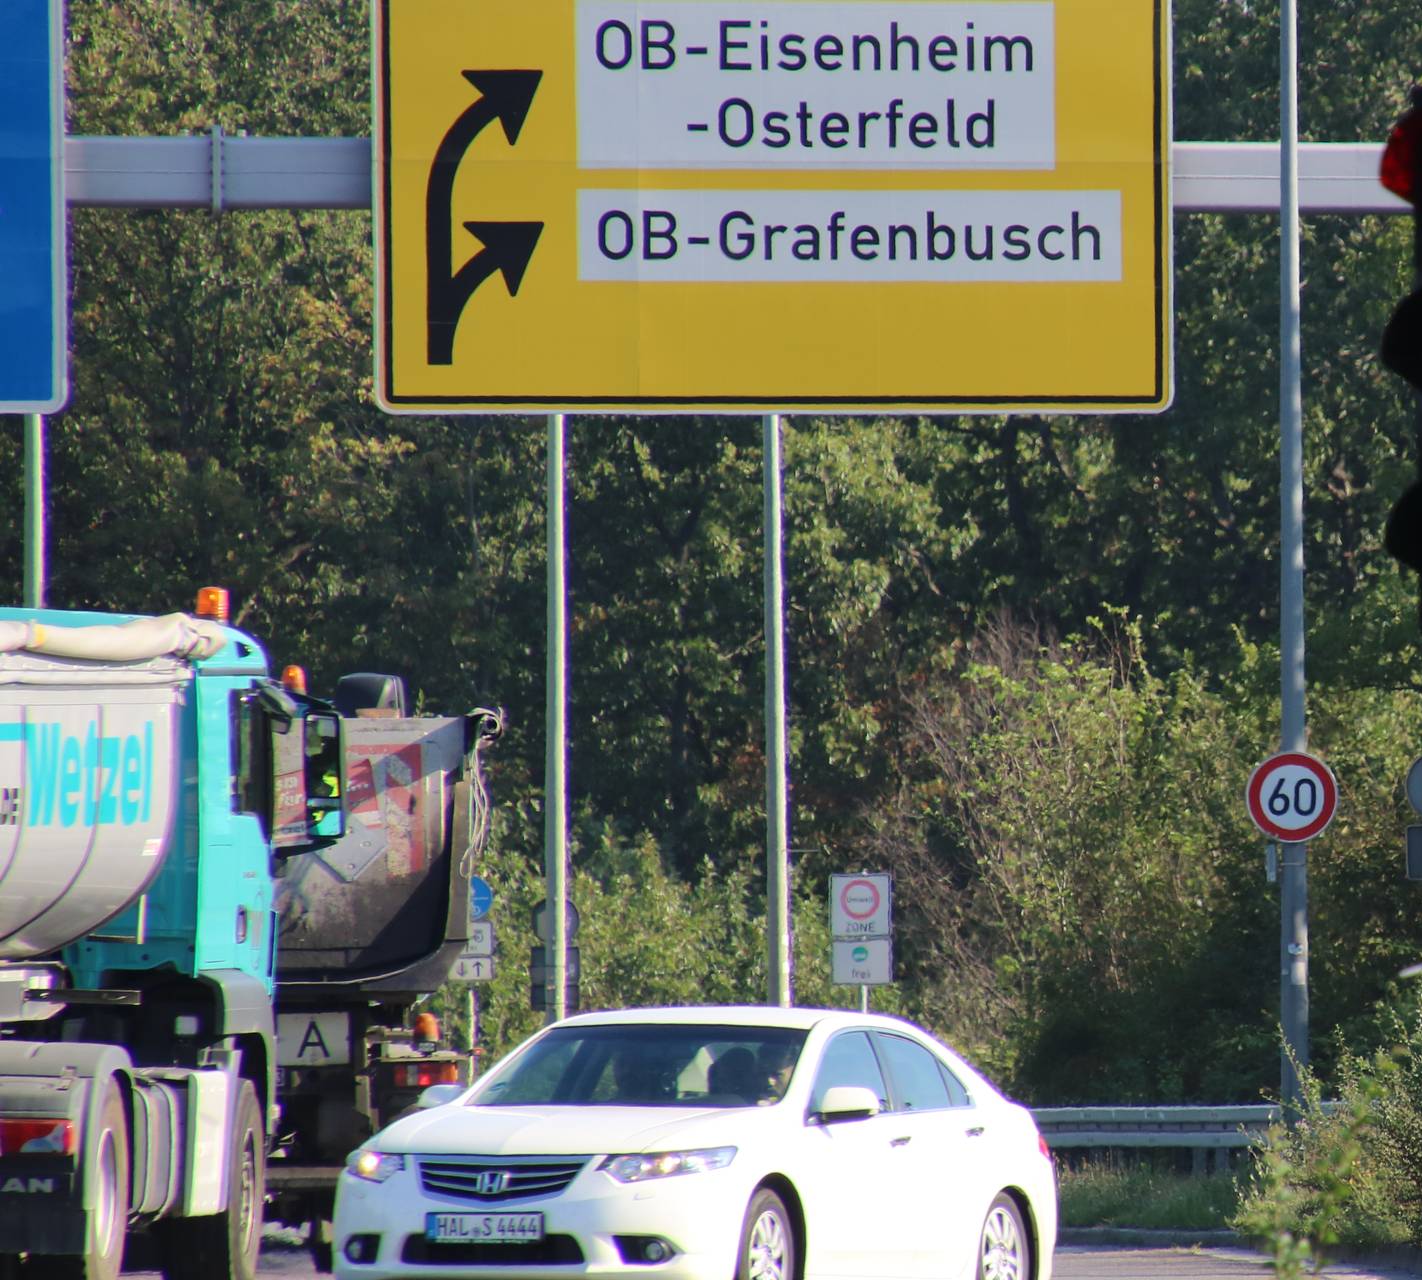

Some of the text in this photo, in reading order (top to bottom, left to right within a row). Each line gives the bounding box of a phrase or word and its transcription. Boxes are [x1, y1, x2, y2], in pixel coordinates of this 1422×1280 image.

[595, 19, 1034, 72] OB-Eisenheim
[686, 97, 996, 149] -Osterfeld
[597, 209, 1101, 262] OB-Grafenbusch
[26, 719, 153, 828] Wetzel
[1267, 777, 1317, 817] 60
[845, 921, 877, 934] ZONE
[297, 1019, 331, 1058] A
[437, 1216, 468, 1237] HAL
[496, 1216, 538, 1237] 4444
